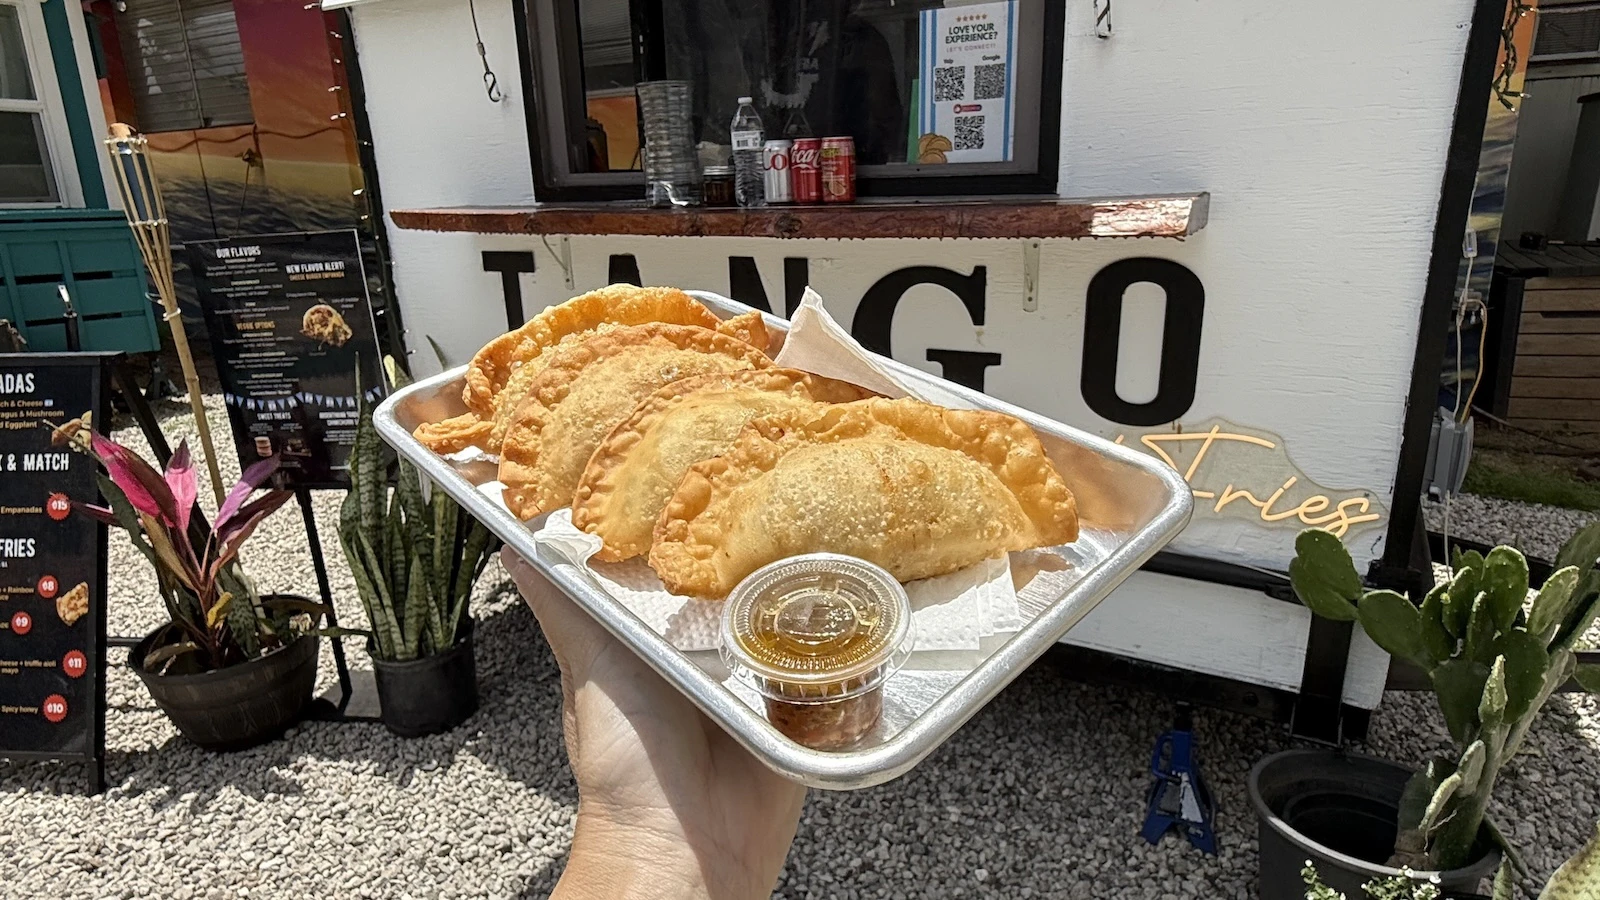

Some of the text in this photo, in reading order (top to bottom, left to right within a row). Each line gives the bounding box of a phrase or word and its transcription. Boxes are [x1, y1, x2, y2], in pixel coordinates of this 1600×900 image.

[949, 23, 994, 35] LOVE YOUR
[945, 32, 998, 44] EXPERIENCE?
[216, 245, 261, 258] OUR FLAVORS
[286, 264, 300, 274] NEW
[301, 262, 324, 273] FLAVOR
[324, 261, 345, 271] ALERT!
[254, 320, 275, 329] OPTIONS
[482, 249, 1207, 428] TGO
[5, 420, 37, 430] Eggplant
[7, 453, 17, 471] &
[23, 453, 70, 471] MATCH
[1, 506, 43, 515] Empanadas
[1, 705, 19, 714] Spicy
